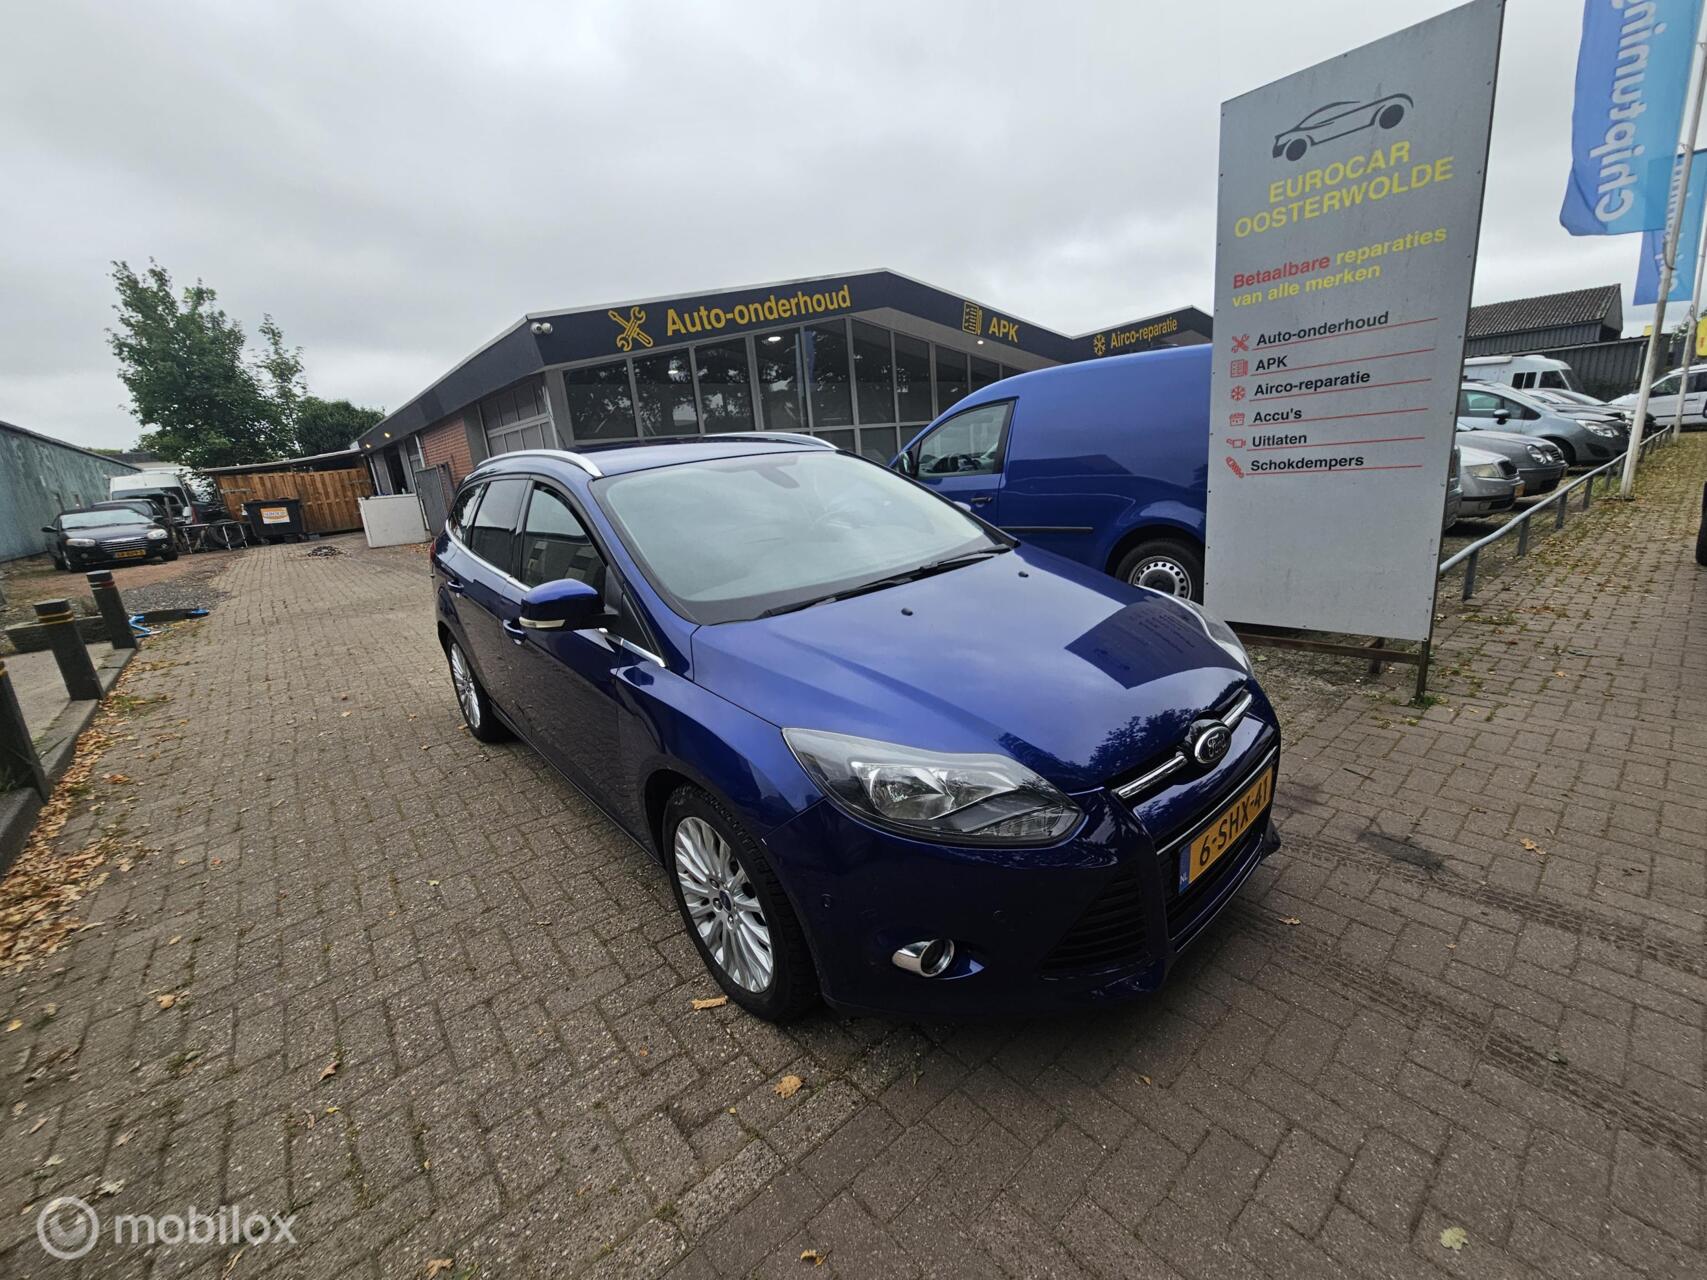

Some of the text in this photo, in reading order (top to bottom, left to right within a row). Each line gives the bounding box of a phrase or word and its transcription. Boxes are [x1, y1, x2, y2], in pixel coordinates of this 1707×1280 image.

[1269, 140, 1411, 204] EUROCAR
[1234, 156, 1455, 239] OOSTERWOLDE
[1233, 227, 1447, 289] Betaalbare reparaties
[1232, 264, 1381, 307] van alle merken
[666, 284, 851, 336] Auto-onderhoud
[988, 317, 1019, 343] APK
[1110, 317, 1178, 349] Airco-reparatie
[1256, 311, 1389, 346] Auto-onderhoud
[1255, 355, 1288, 372] APK
[1254, 371, 1370, 396] Airco-reparatie
[1253, 407, 1303, 424] Accu's
[1252, 432, 1308, 449] Uitlaten
[1250, 453, 1365, 472] Schokdempers
[1200, 776, 1268, 866] 6-SHX-41
